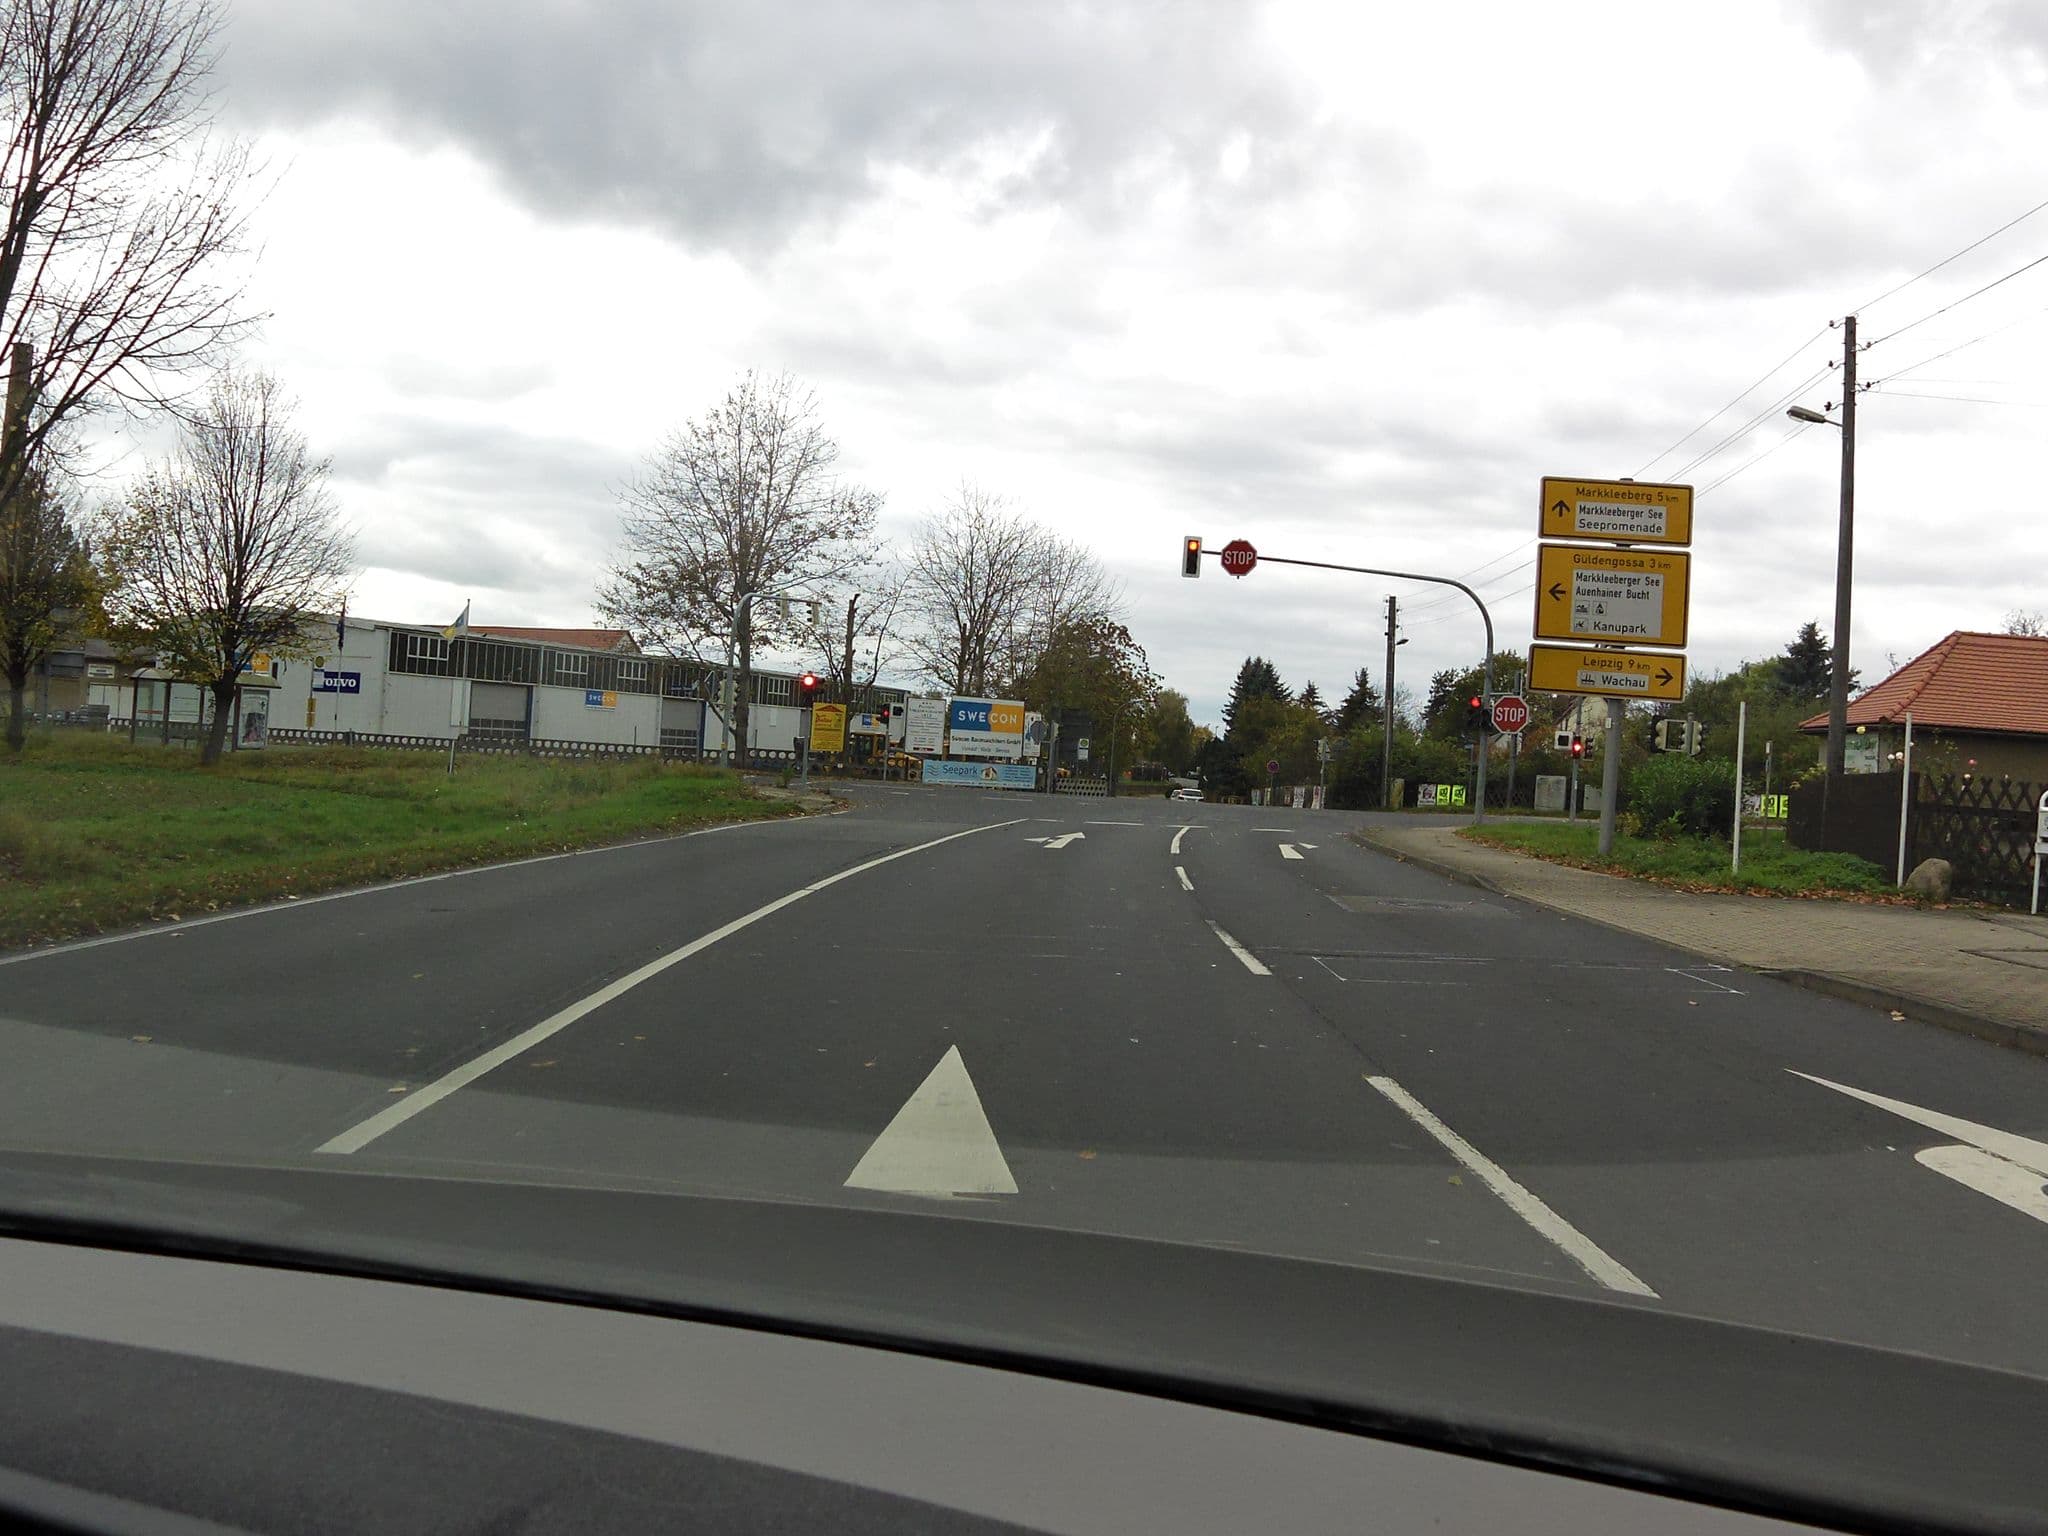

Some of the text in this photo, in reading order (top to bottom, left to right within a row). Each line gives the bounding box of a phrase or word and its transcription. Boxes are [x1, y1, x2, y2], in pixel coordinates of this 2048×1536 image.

[1576, 487, 1652, 503] Markkleeberg
[1657, 492, 1664, 501] 5
[1579, 504, 1663, 520] Markkleeberger See
[1579, 519, 1663, 534] Seepromenade
[1224, 550, 1253, 565] STOP
[1650, 558, 1656, 569] 3
[1575, 572, 1660, 587] Markkleeberger See
[1575, 586, 1650, 601] Auenhainer Bucht
[1593, 621, 1647, 635] Kanupark
[1583, 656, 1650, 670] Leipzig 9 km
[324, 678, 357, 688] OLVO
[1601, 676, 1646, 688] Wachau
[958, 710, 1017, 725] SWECON
[1495, 707, 1525, 722] STOP
[942, 764, 978, 776] Seepark
